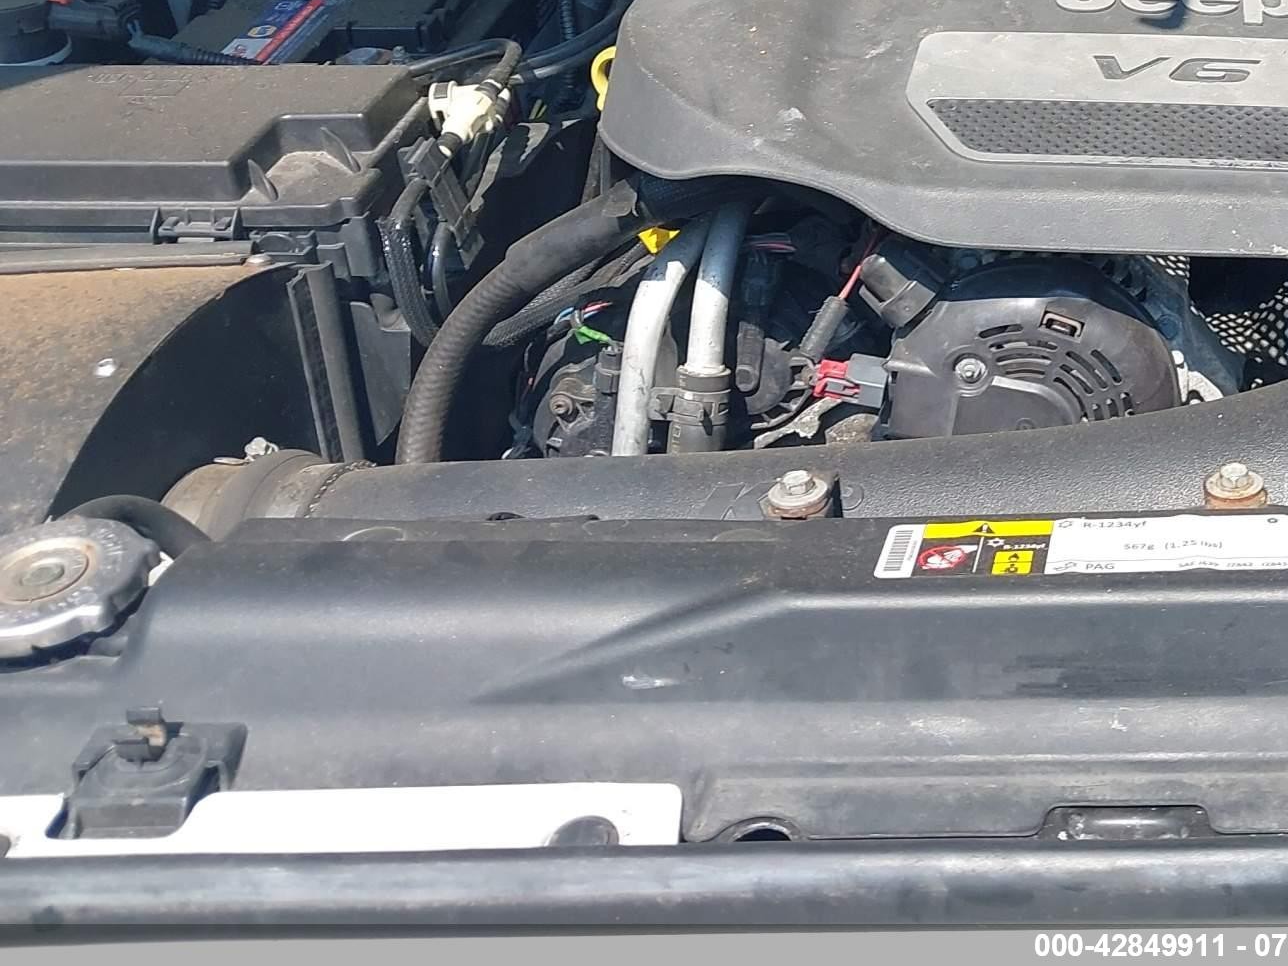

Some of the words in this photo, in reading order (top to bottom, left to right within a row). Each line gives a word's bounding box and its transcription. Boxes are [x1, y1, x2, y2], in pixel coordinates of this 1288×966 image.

[1093, 55, 1262, 83] V6
[1082, 520, 1148, 529] R-1234yf
[1085, 562, 1116, 571] PAG
